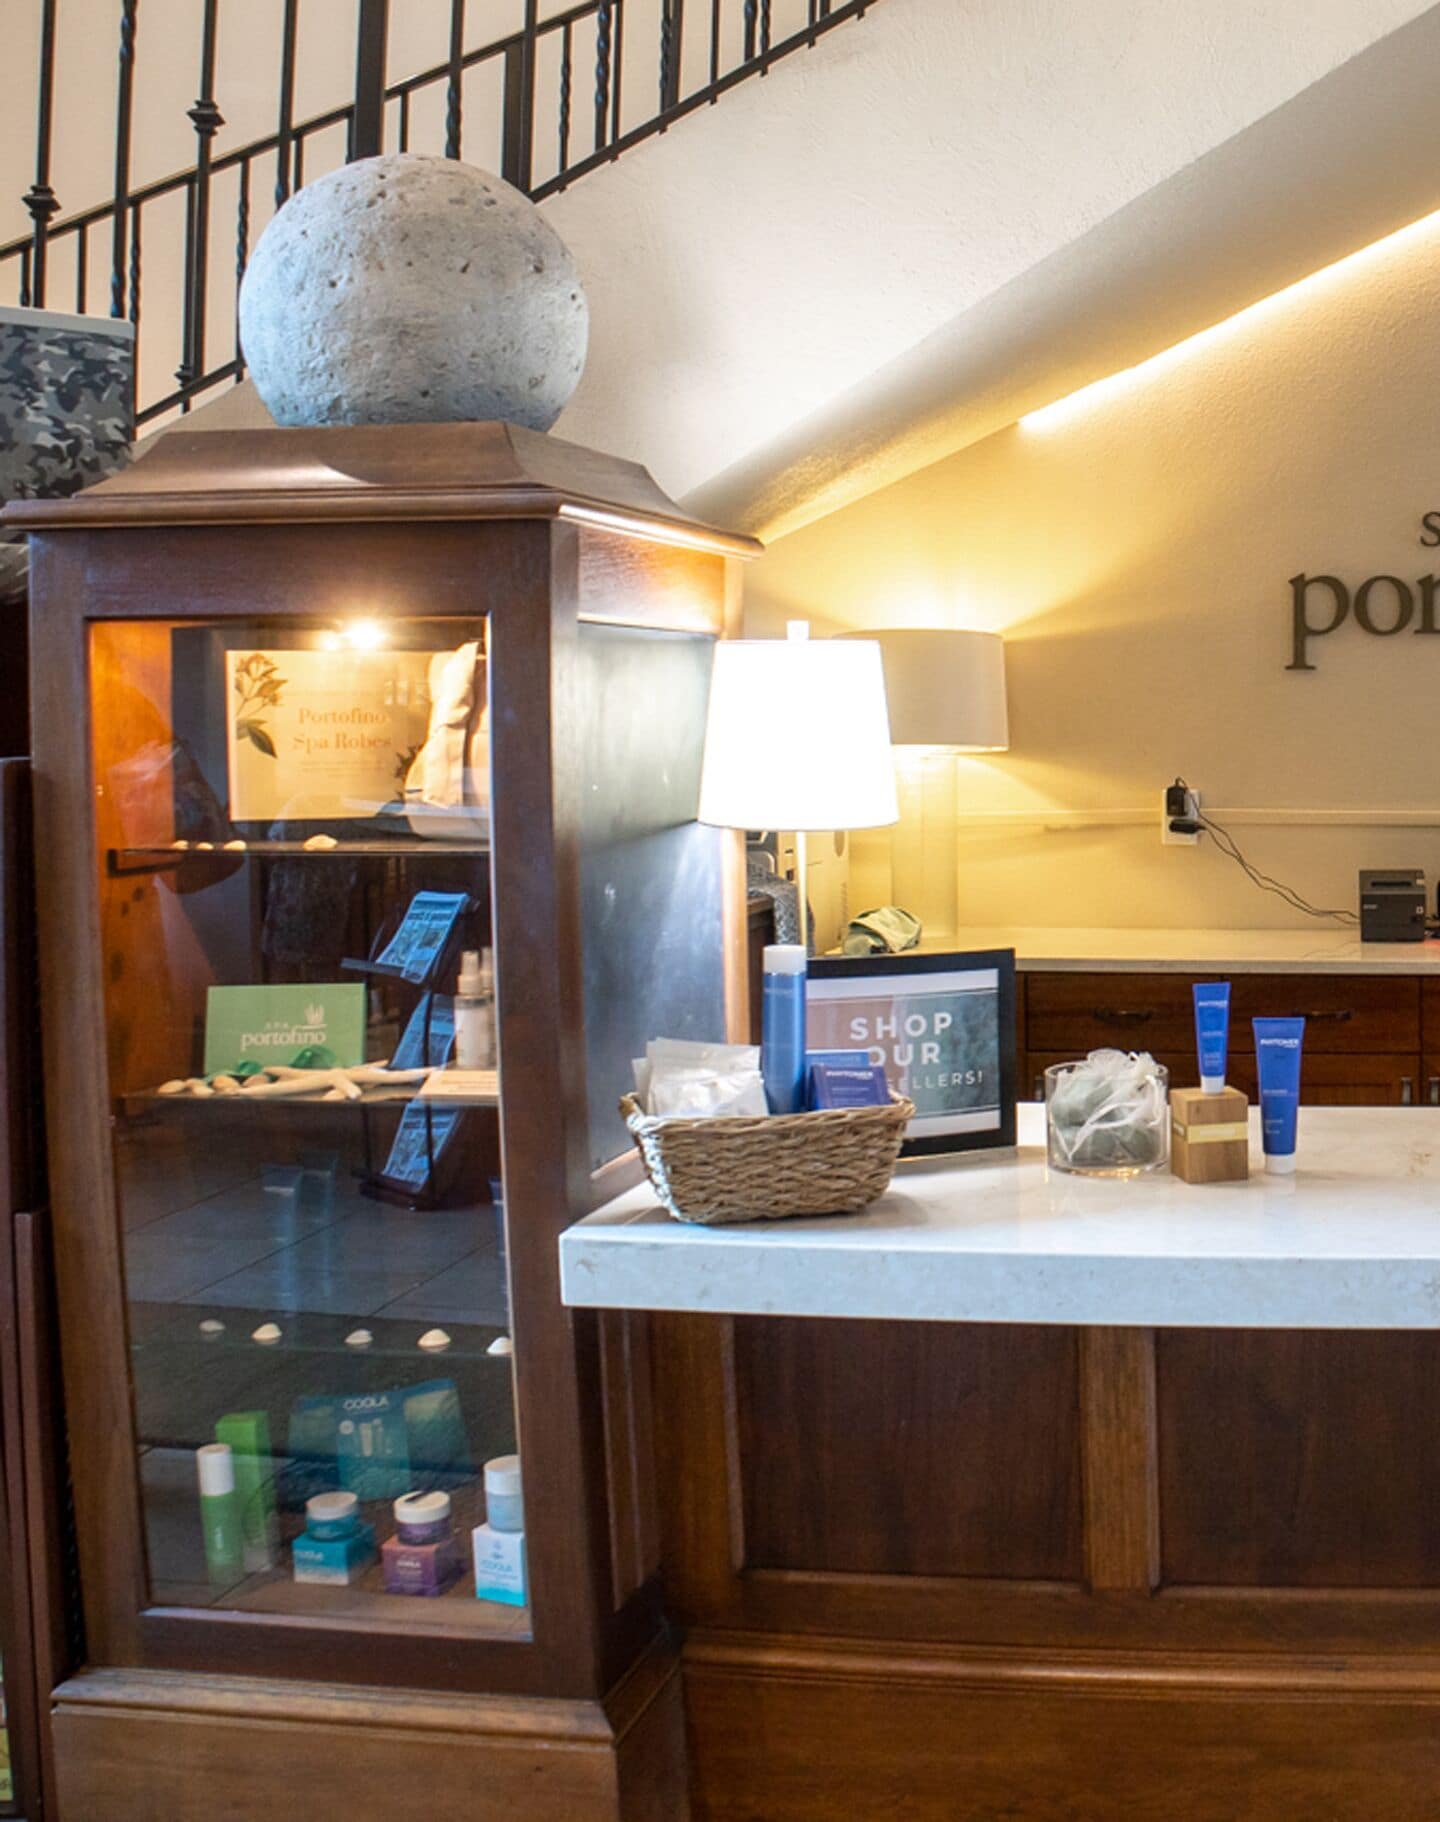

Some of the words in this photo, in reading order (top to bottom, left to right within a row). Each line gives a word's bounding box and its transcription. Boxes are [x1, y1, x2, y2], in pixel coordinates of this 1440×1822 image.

[298, 708, 386, 725] Portofino
[293, 733, 329, 754] Spa
[335, 732, 392, 750] Robes
[241, 1025, 327, 1051] portofino
[849, 1011, 953, 1041] SHOP
[868, 1041, 941, 1067] OUR
